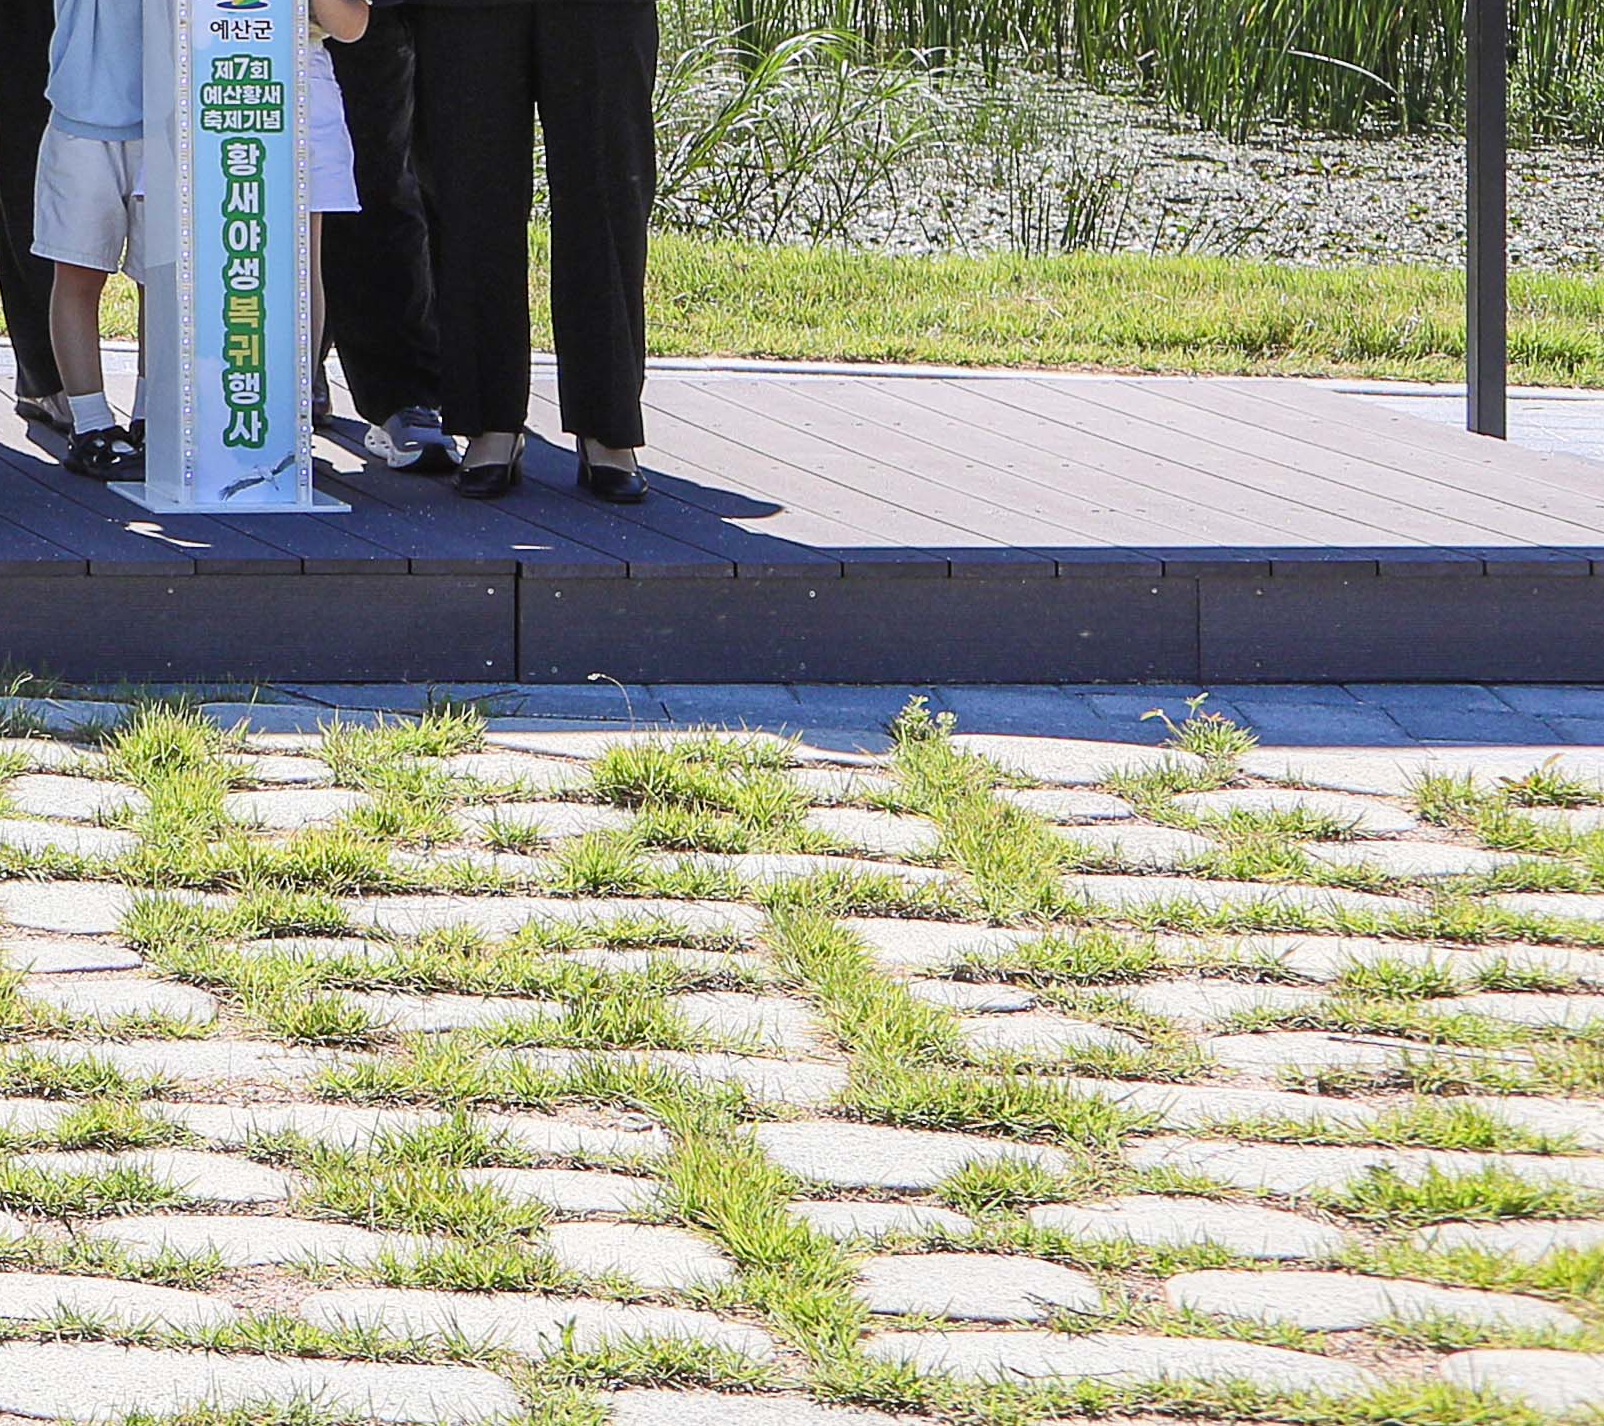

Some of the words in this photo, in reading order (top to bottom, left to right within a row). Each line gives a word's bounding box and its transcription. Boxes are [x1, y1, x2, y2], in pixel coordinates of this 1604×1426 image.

[209, 19, 273, 41] 예산군
[213, 57, 269, 82] 제7회
[203, 84, 281, 107] 예산황새
[203, 108, 281, 131] 축제기념
